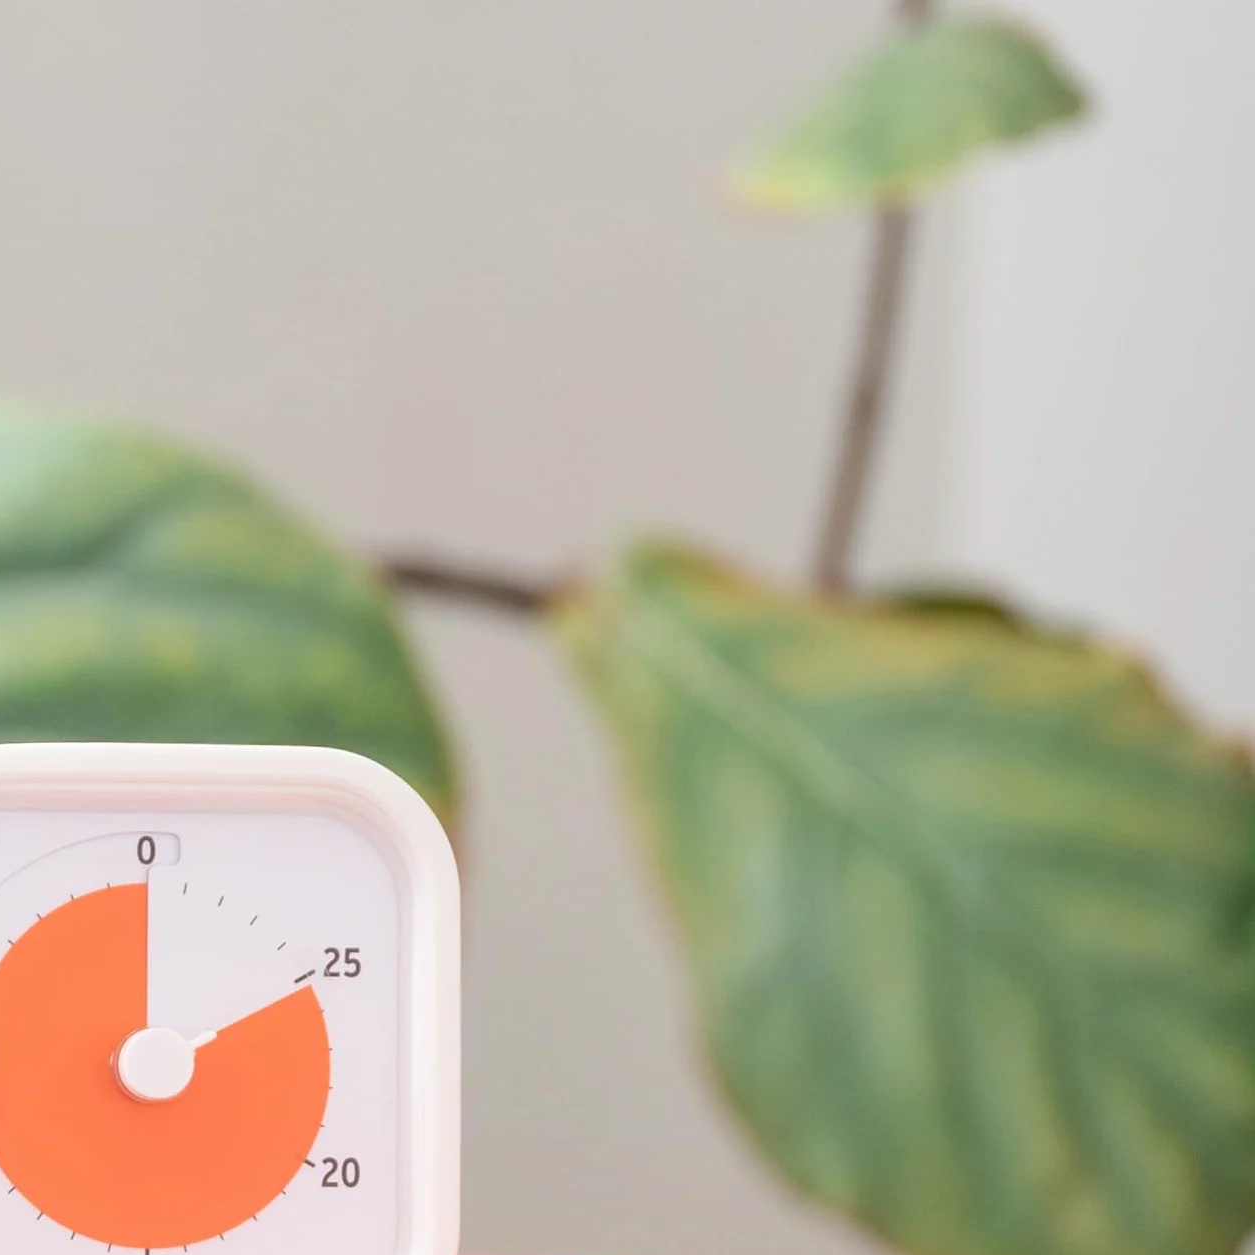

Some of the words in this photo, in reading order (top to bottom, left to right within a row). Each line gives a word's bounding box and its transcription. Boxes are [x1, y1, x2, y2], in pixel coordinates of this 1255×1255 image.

[136, 835, 156, 865] 0
[322, 947, 362, 978] 25
[320, 1157, 361, 1188] 20
